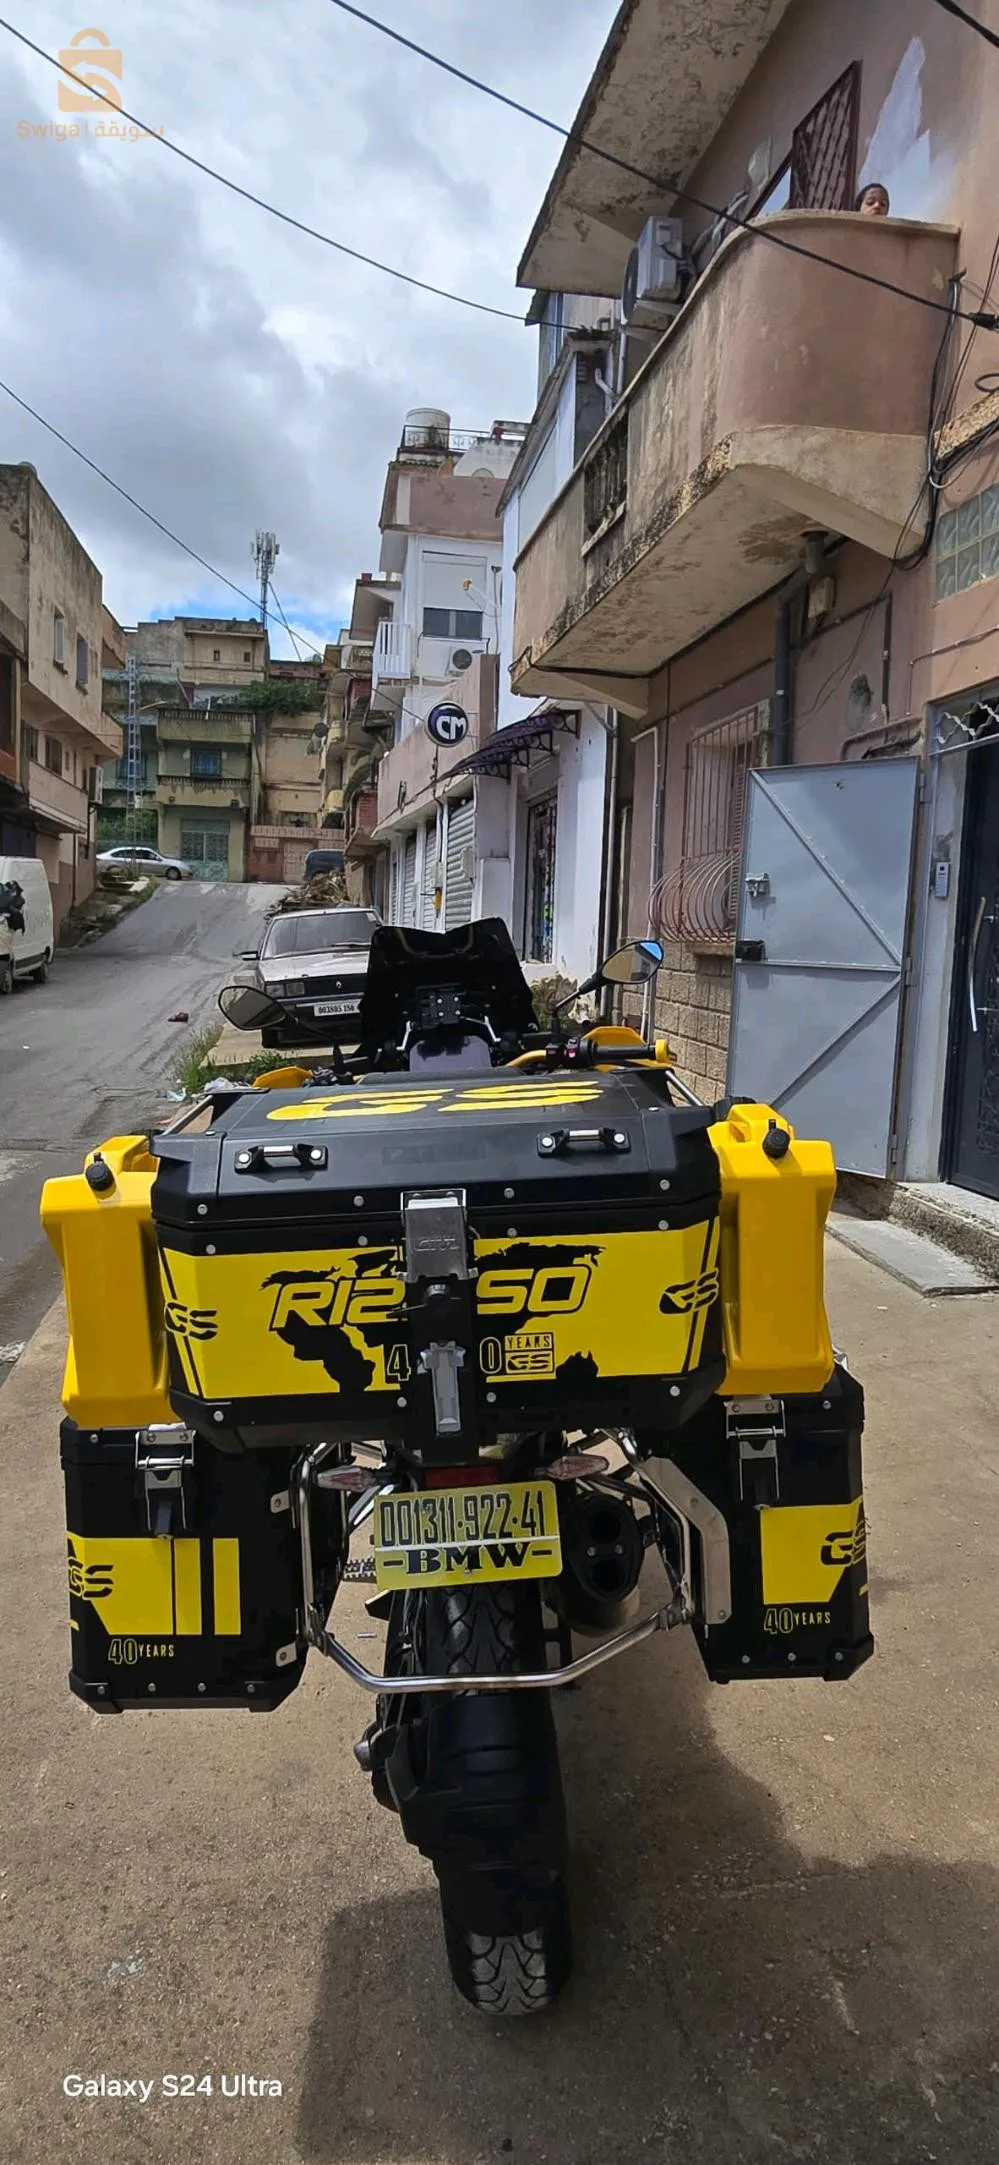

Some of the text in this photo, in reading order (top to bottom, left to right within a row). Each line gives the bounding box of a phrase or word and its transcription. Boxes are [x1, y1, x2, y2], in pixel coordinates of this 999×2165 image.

[266, 1081, 604, 1121] GS
[659, 1267, 719, 1316] GS
[164, 1301, 219, 1342] GS
[507, 1336, 551, 1350] YEARS
[794, 1611, 832, 1626] YEARS
[108, 1638, 175, 1665] 40 YEARS
